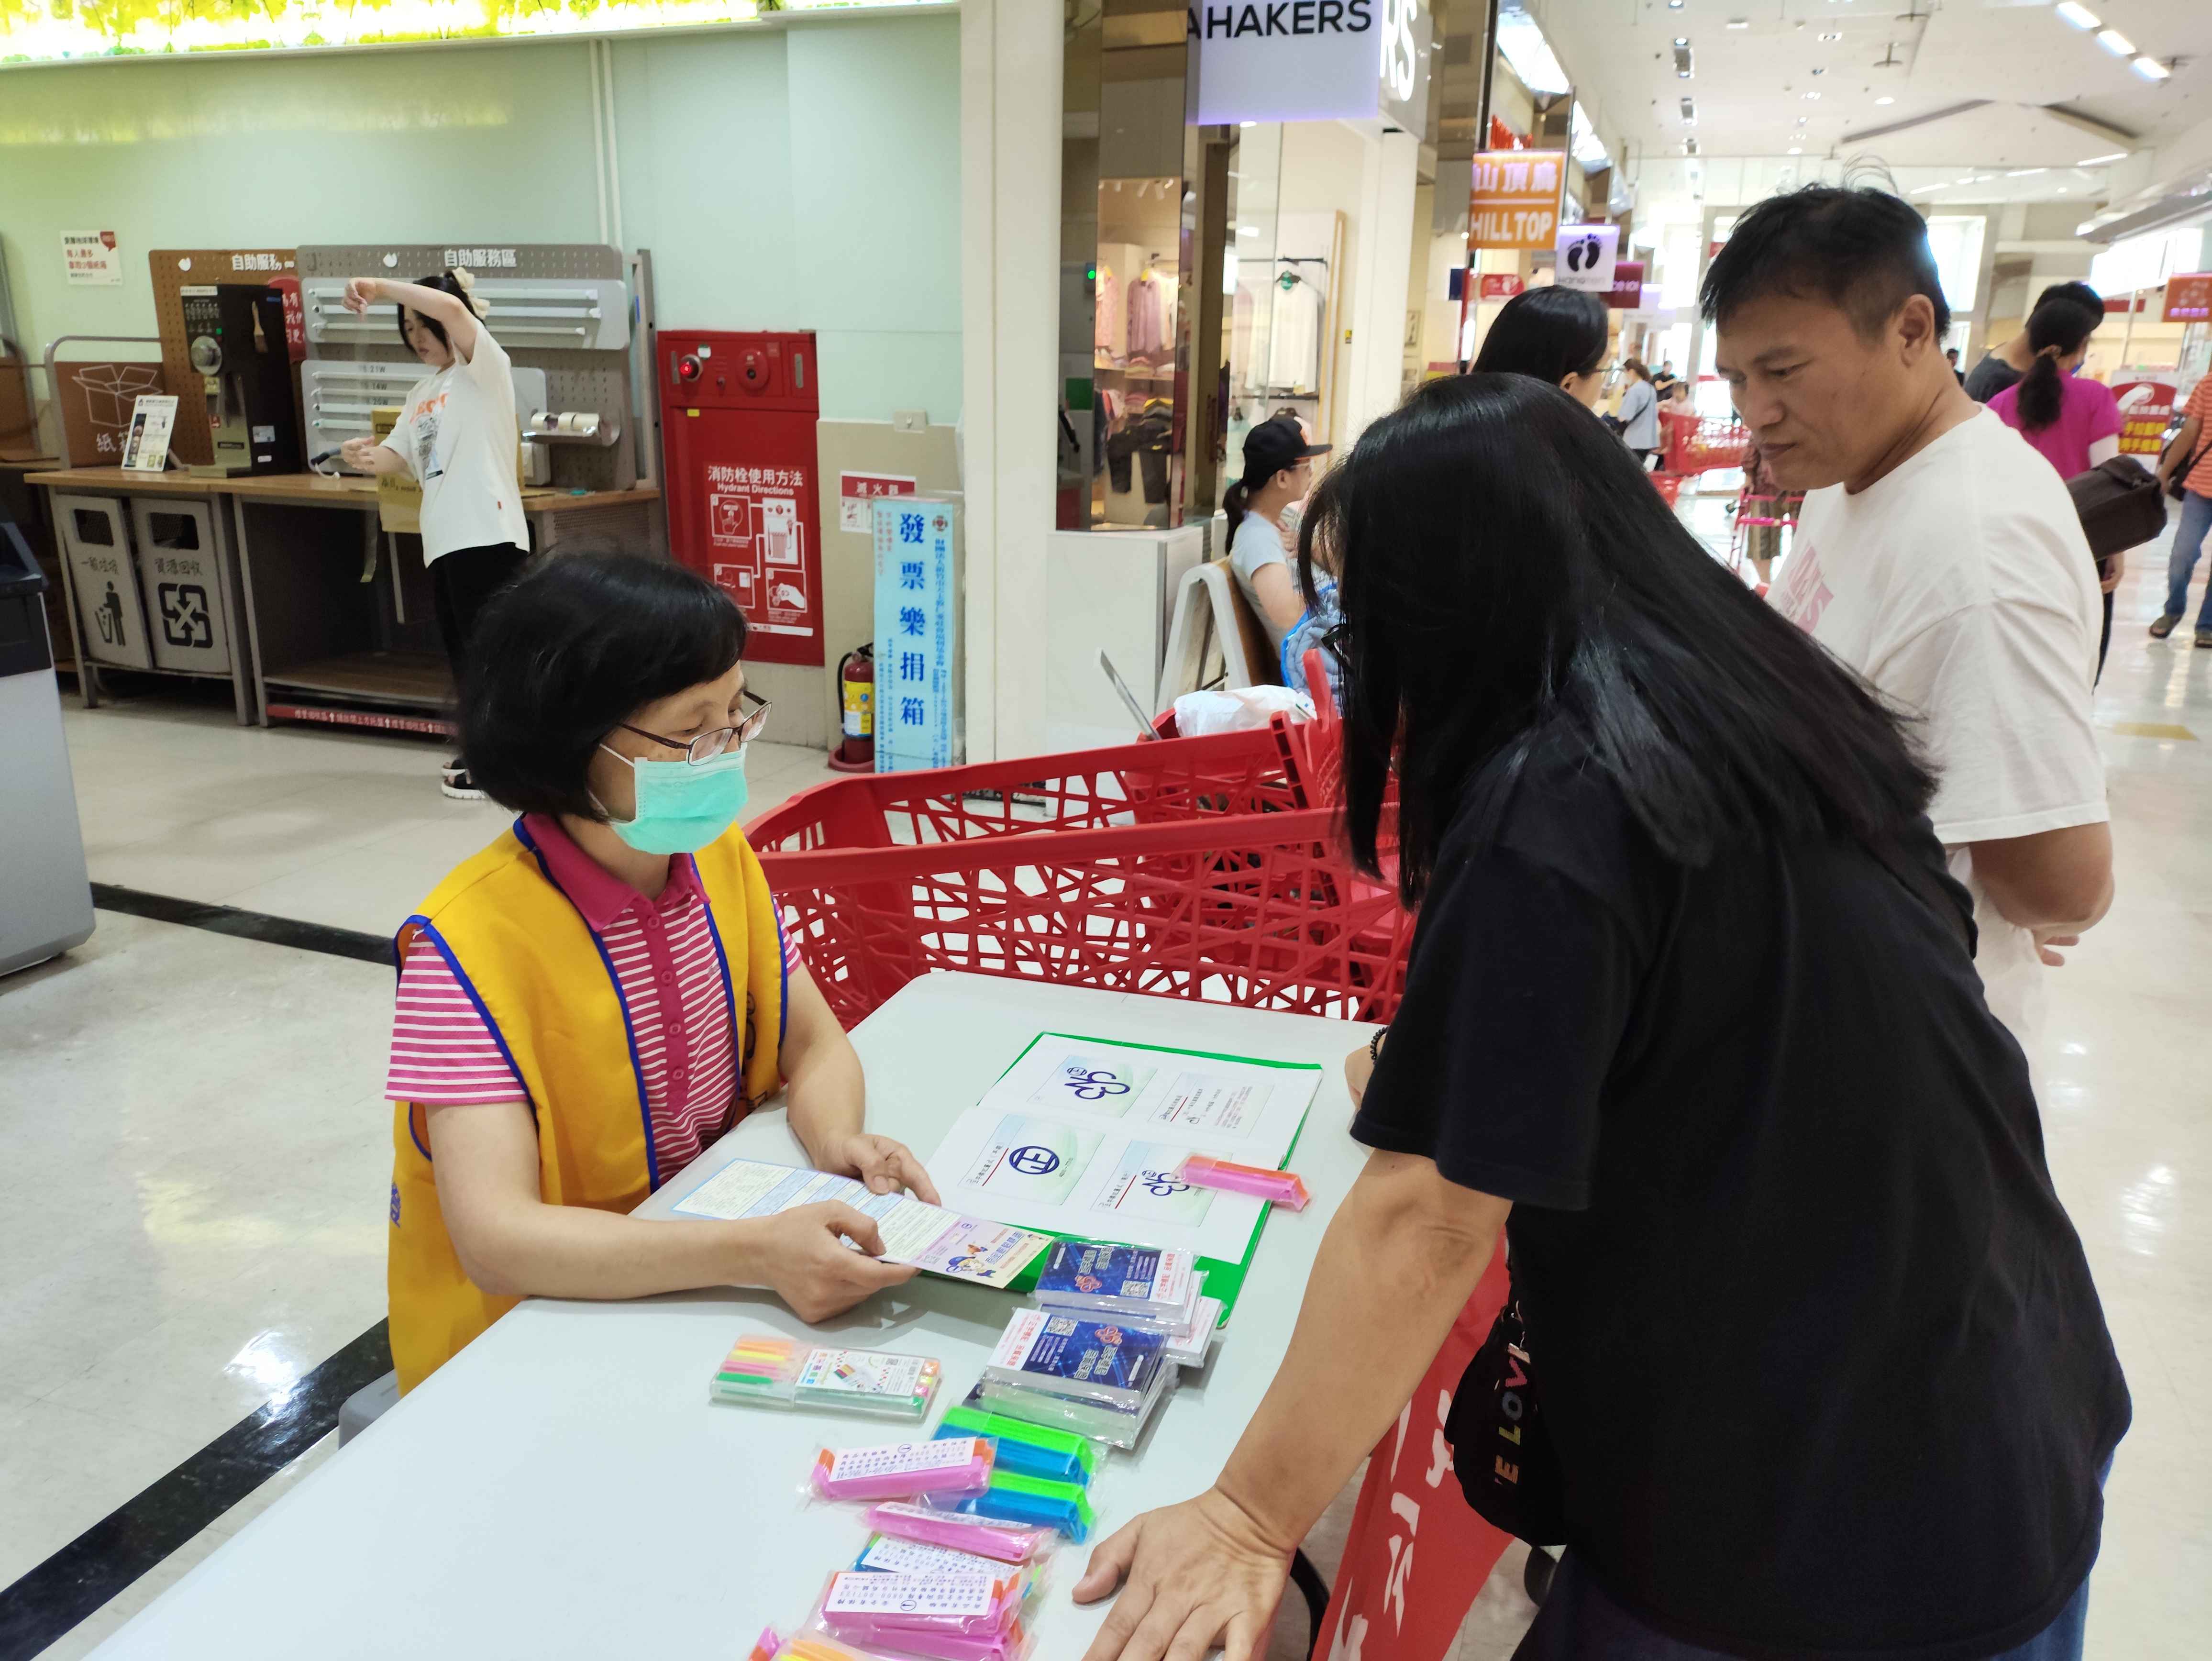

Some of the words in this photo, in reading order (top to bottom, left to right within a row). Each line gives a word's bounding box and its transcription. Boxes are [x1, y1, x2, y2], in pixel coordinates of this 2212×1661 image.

[1471, 212, 1552, 242] HILLTOP
[444, 248, 517, 267] 自助服務區
[708, 465, 804, 487] 消防栓使用方法
[718, 483, 750, 493] Hydrant
[752, 484, 794, 496] Directions
[856, 481, 899, 495] 滅火器
[155, 557, 203, 576] 資源回收
[900, 513, 926, 727] 發票樂捐箱
